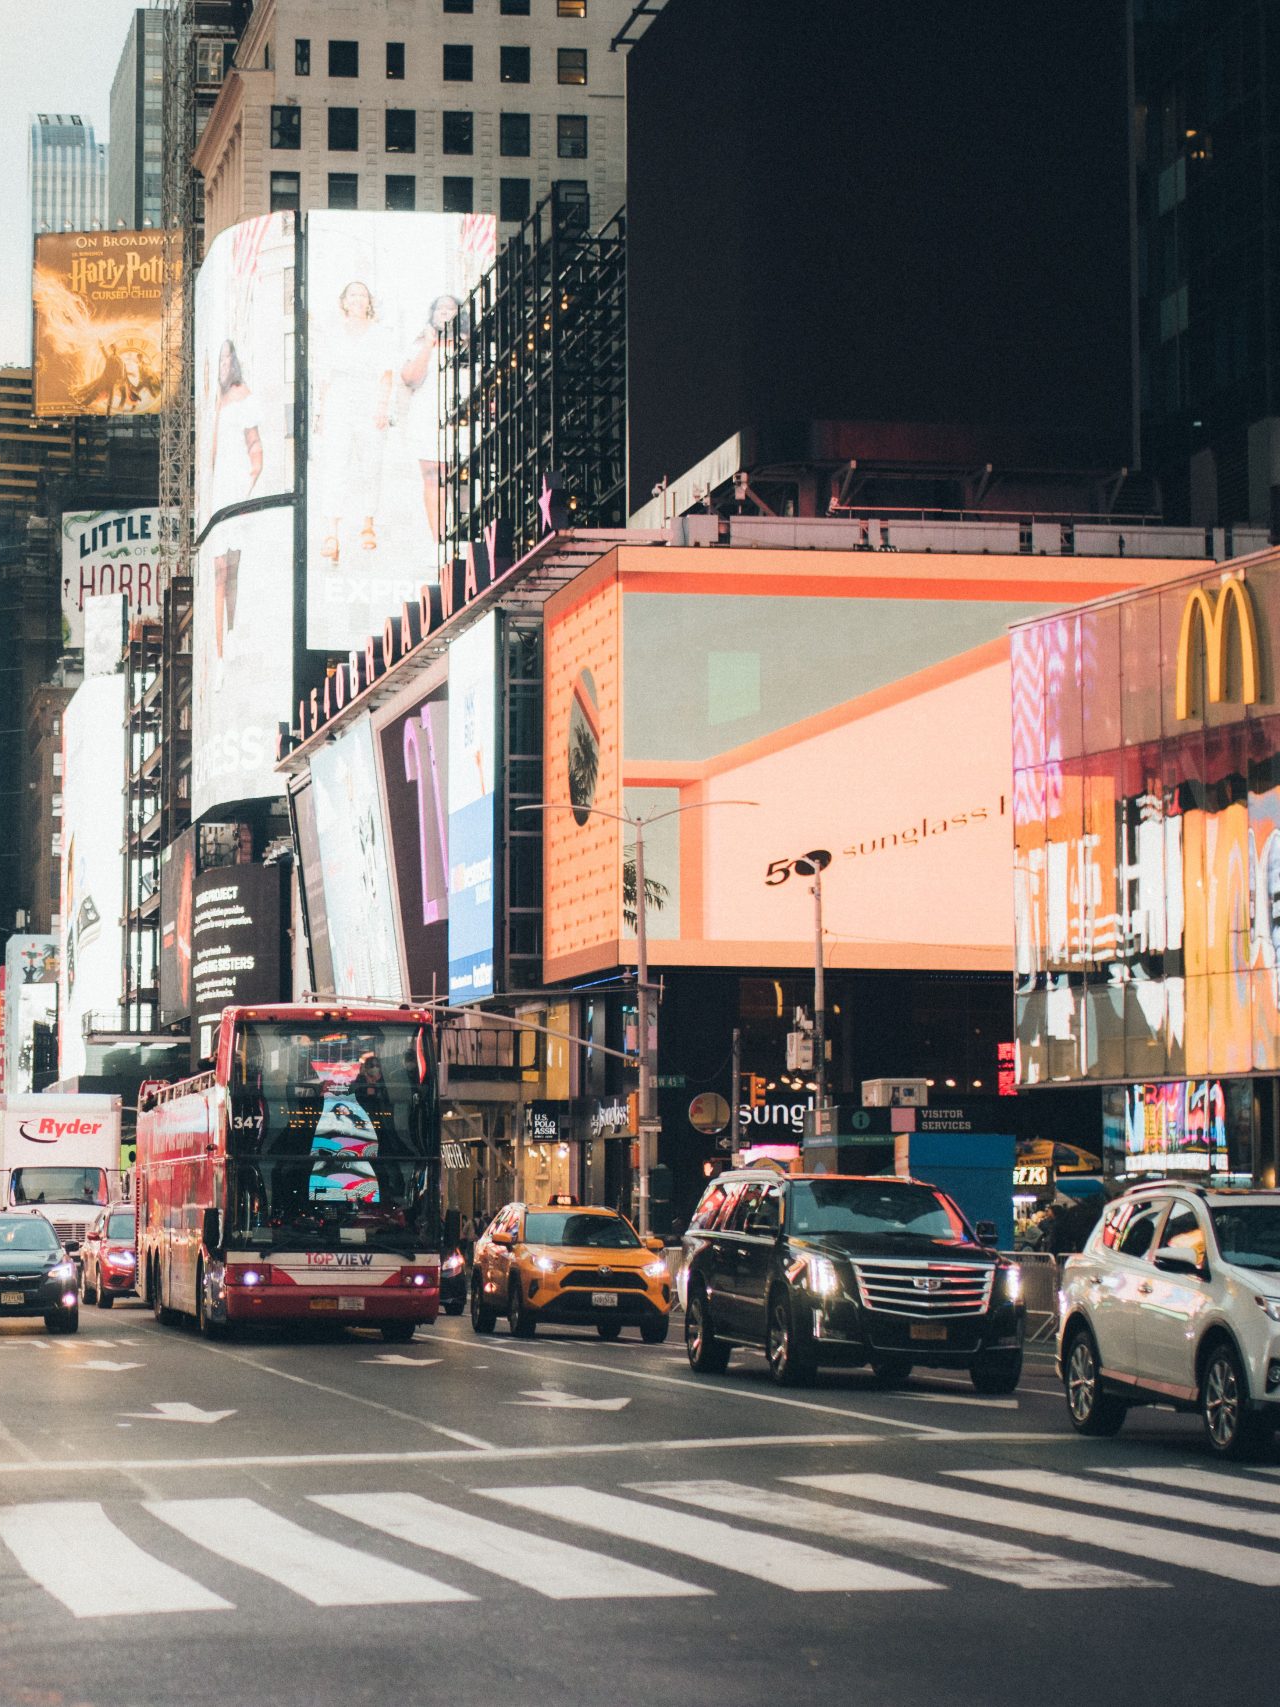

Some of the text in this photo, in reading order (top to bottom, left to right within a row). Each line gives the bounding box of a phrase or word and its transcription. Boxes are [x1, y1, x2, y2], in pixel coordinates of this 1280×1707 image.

[68, 256, 126, 294] Harry
[91, 289, 162, 301] CURSED CHILD
[79, 514, 152, 560] LITTLE
[298, 663, 344, 742] 1540
[348, 517, 498, 699] BROADWAY
[841, 807, 989, 858] sunglass
[233, 1115, 264, 1129] 347
[921, 1109, 964, 1119] VISITOR
[38, 1118, 103, 1138] Ryder
[534, 1120, 556, 1128] POLO
[921, 1120, 972, 1130] SERVICES
